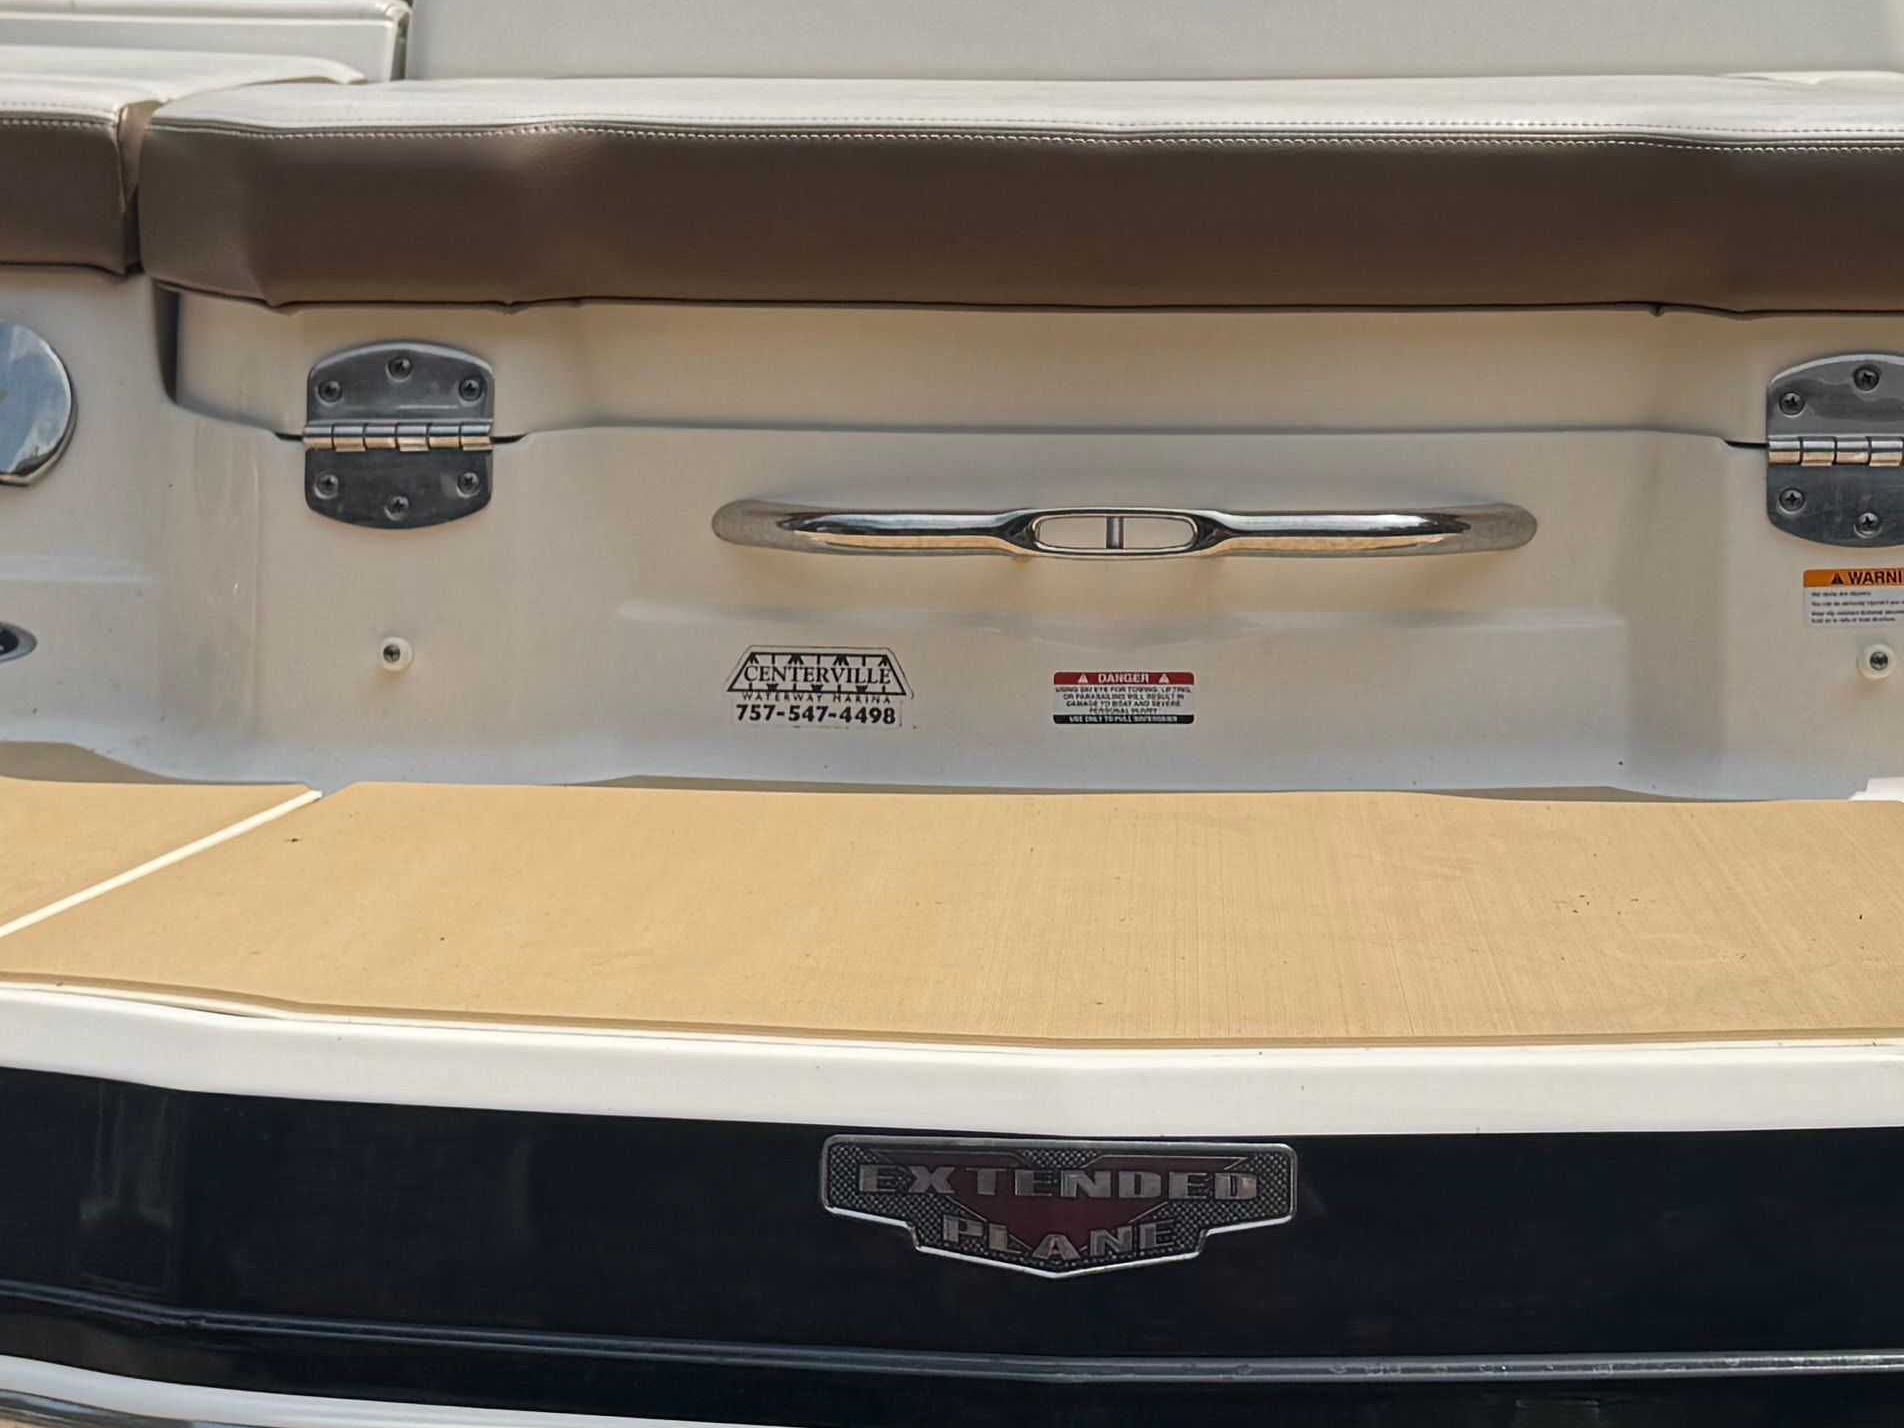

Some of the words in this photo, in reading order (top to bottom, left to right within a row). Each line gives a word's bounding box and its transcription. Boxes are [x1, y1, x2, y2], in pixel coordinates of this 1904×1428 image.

[743, 665, 891, 684] CENTERVILLE
[1098, 673, 1149, 683] DANGER
[742, 692, 823, 702] WATERWAY
[833, 694, 891, 704] MARINA
[736, 704, 896, 724] 757-547-4498
[859, 1164, 1258, 1200] EXTENDED
[942, 1215, 1177, 1261] PLANE
